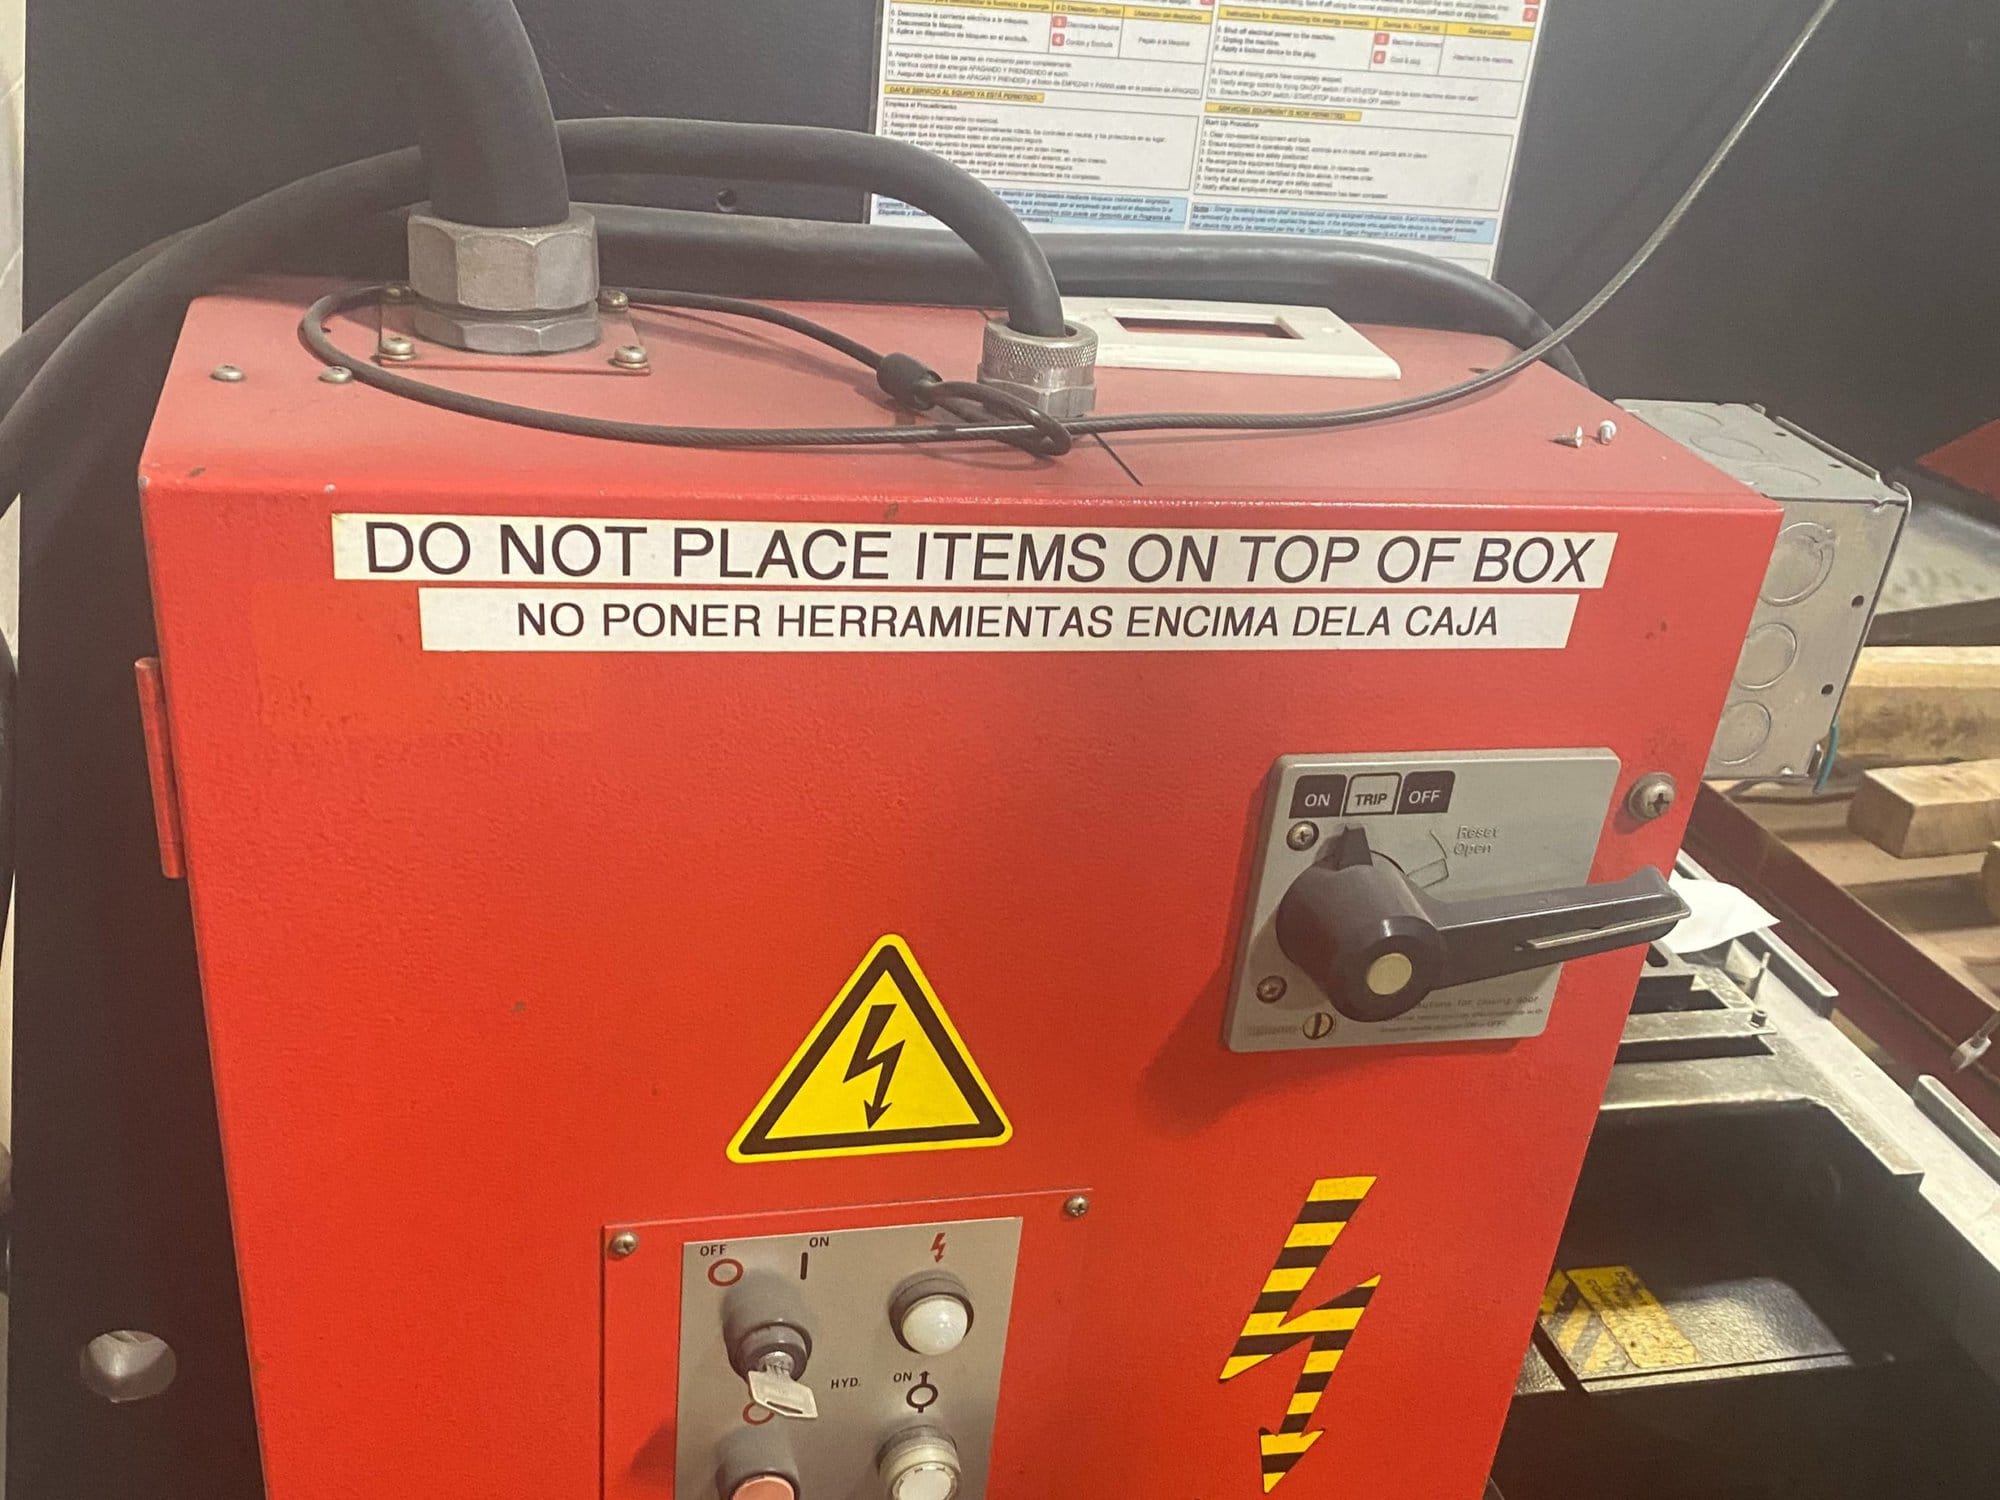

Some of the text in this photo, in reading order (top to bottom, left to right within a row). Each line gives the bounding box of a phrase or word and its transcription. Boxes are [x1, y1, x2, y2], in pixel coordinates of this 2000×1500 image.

[365, 521, 1596, 583] DO NOT PLACE ITEMS ON TOP OF BOX
[517, 602, 1497, 639] NO PONER HERRAMIENTAS ENCIMA DELA CAJA
[1304, 793, 1331, 807] ON
[1354, 792, 1388, 807] TRIP
[1408, 789, 1441, 804] OFF
[1457, 825, 1499, 840] Reset
[1454, 842, 1493, 857] Open
[809, 1236, 830, 1248] ON
[699, 1243, 727, 1257] OFF
[893, 1371, 913, 1383] ON
